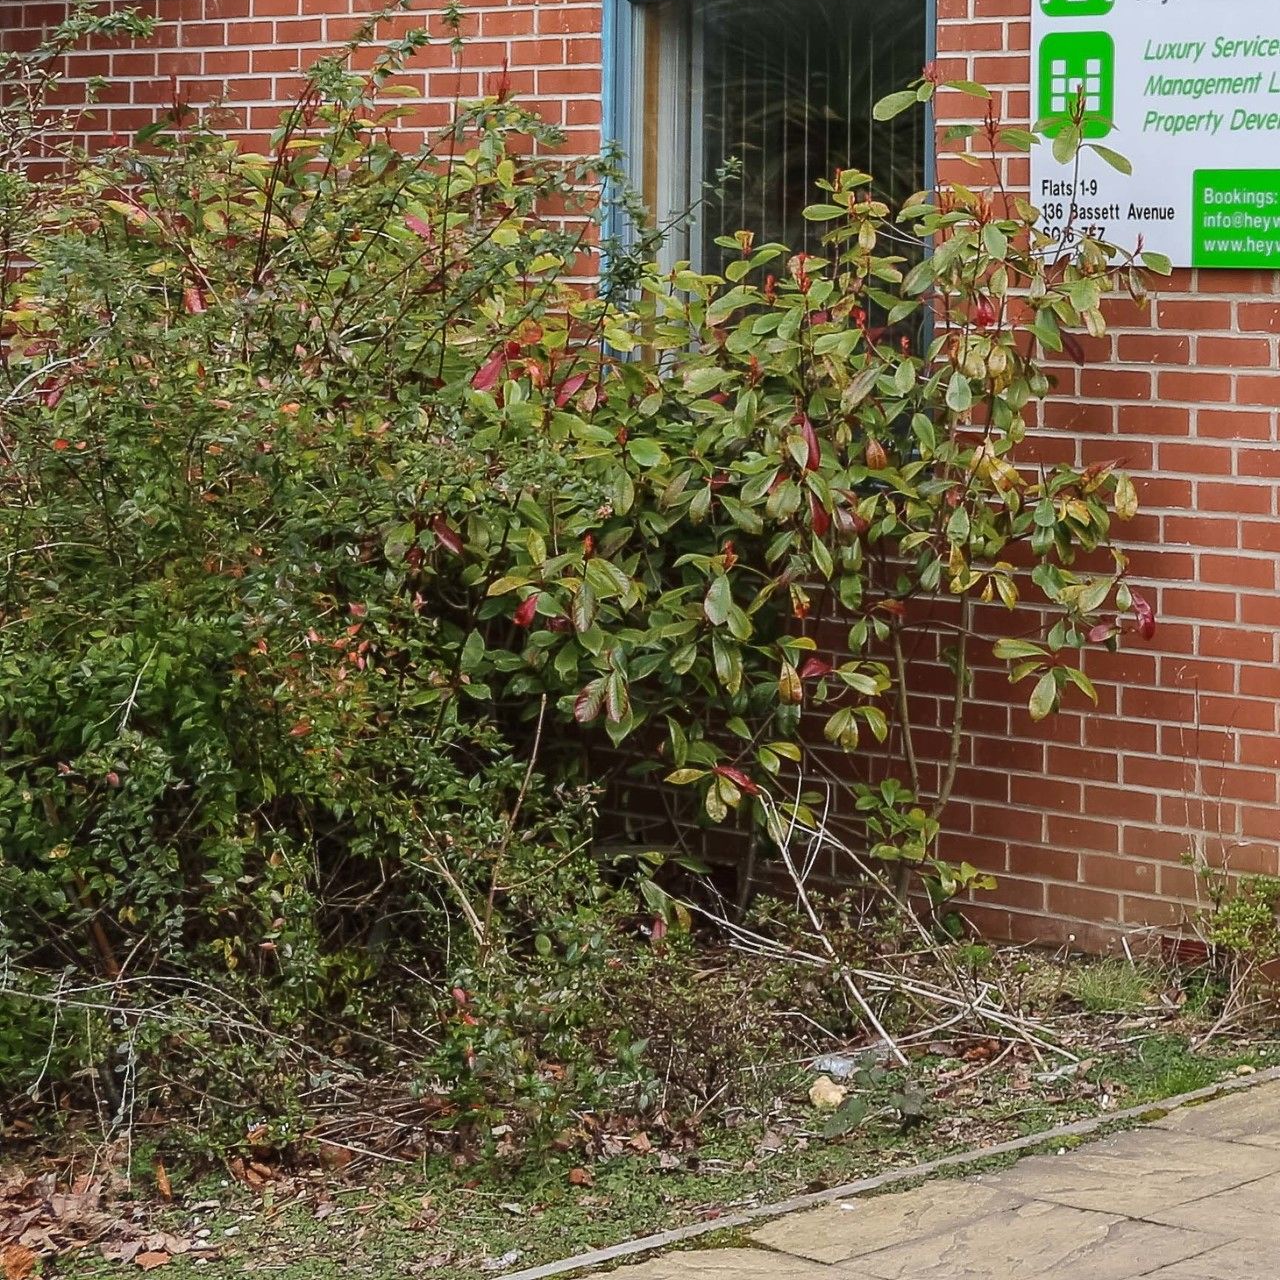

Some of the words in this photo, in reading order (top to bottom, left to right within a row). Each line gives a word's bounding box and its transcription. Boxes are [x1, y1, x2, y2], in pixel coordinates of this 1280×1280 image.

[1144, 39, 1206, 63] Luxury
[1143, 72, 1263, 99] Management
[1143, 109, 1224, 136] Property
[1041, 179, 1073, 196] Flats
[1079, 179, 1098, 196] 1-9
[1203, 187, 1278, 208] Bookings:
[1042, 203, 1063, 220] 136
[1070, 203, 1120, 220] Bassett
[1127, 203, 1175, 220] Avenue
